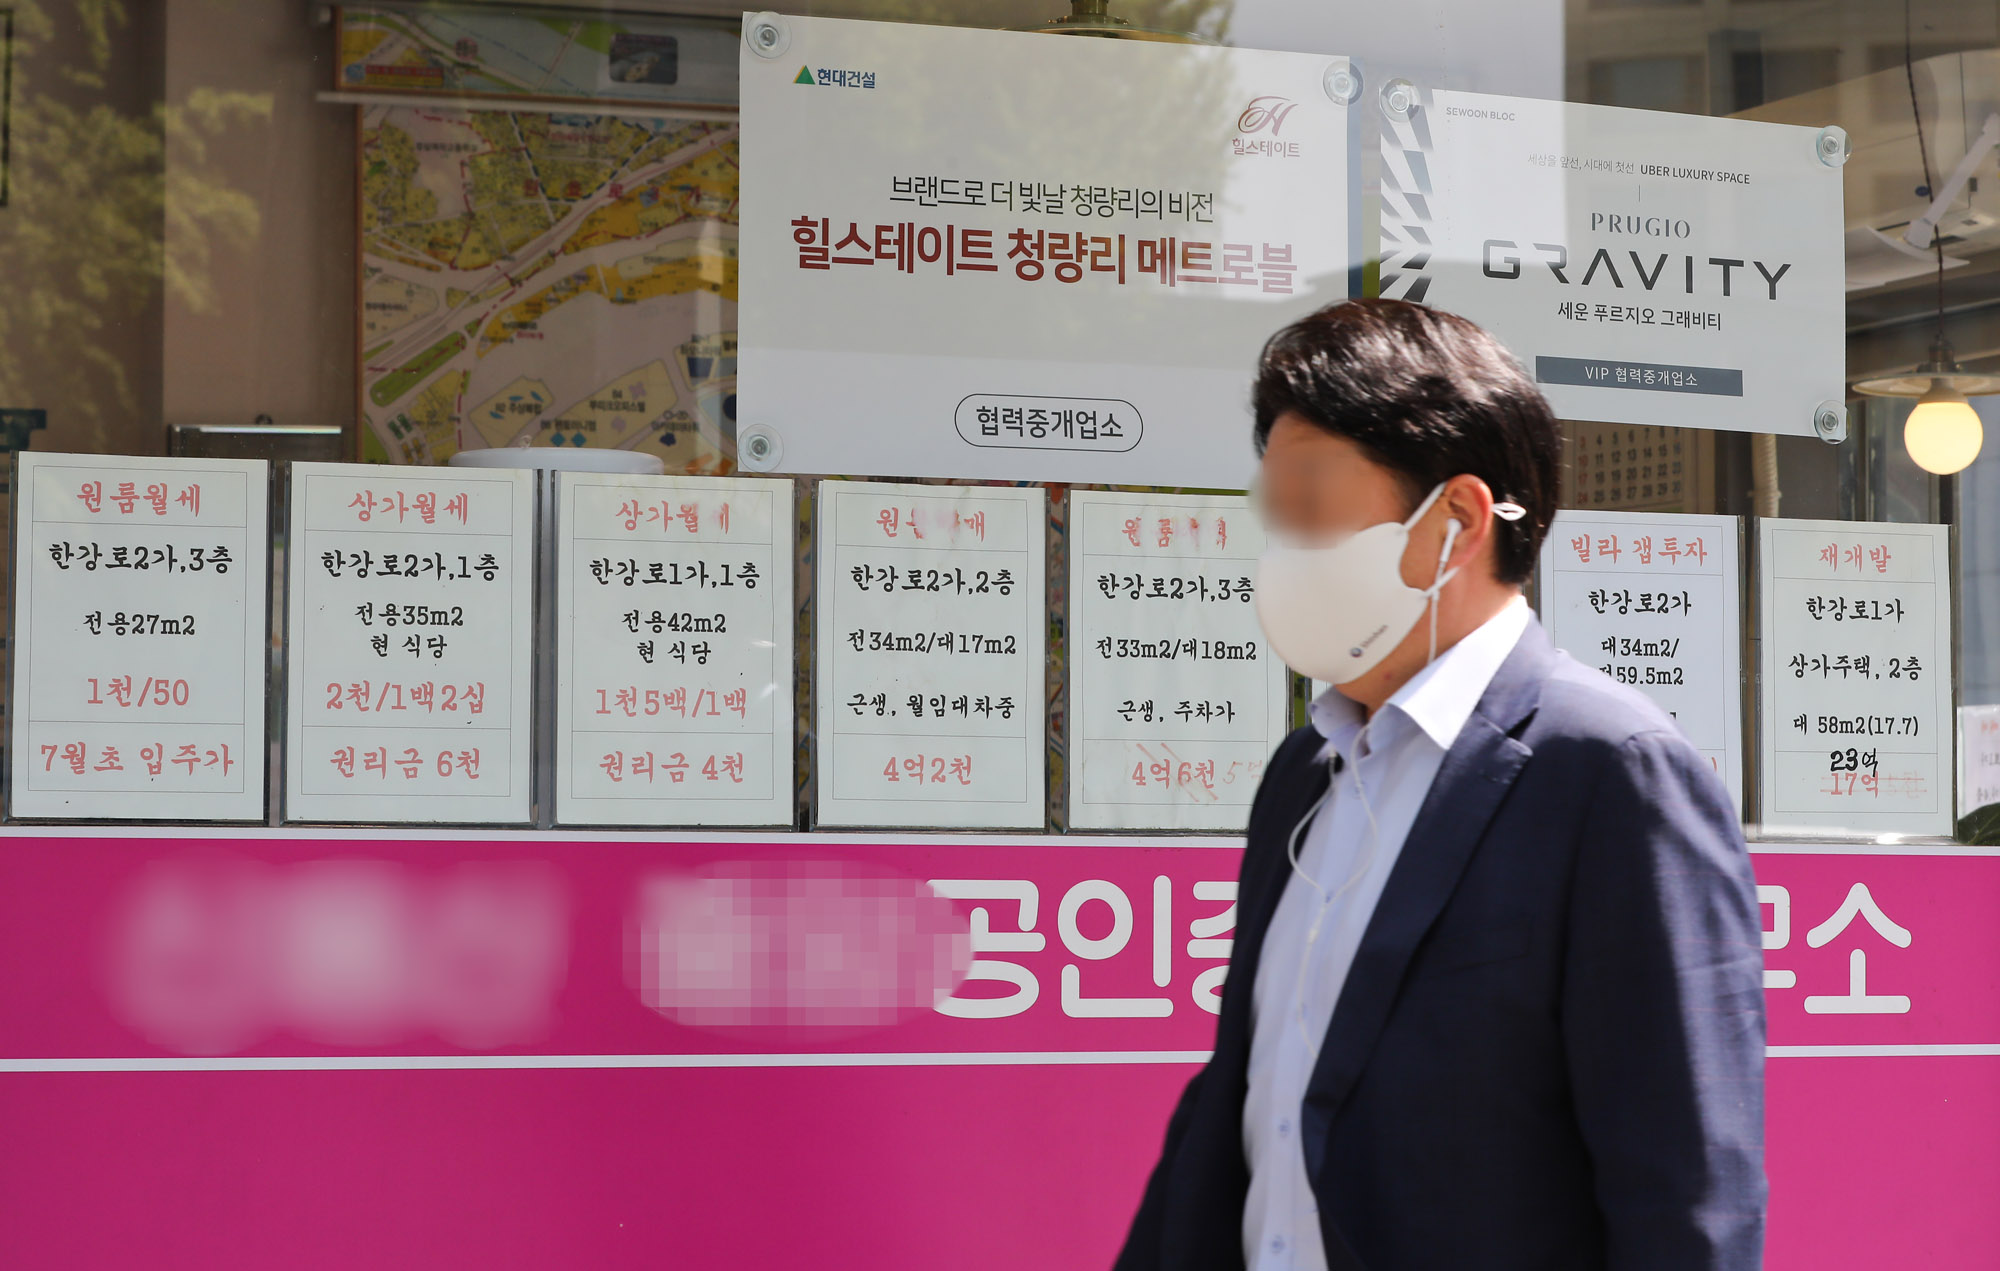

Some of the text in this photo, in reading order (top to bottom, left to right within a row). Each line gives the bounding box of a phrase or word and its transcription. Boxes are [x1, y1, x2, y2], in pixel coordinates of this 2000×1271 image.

[818, 69, 875, 88] 현대건설
[1445, 106, 1516, 122] SEWOON BLOC
[1231, 136, 1302, 159] 힐스테이트
[1560, 155, 1582, 171] 앞선,
[1584, 158, 1613, 173] 시대에
[1615, 159, 1635, 175] 첫선
[1641, 165, 1669, 176] UBER
[1673, 168, 1714, 180] LUXURY
[1717, 172, 1750, 184] SPACE
[890, 176, 1213, 222] 브랜드로 더 빛날 청량리의 비전
[1592, 213, 1690, 238] PRUGIO
[791, 216, 1298, 294] 힐스테이트 청량리 메트로블
[1482, 240, 1792, 300] GRAVITY
[1558, 302, 1720, 331] 세운 푸르지오 그래비티
[1585, 367, 1698, 387] VIP 협력중개업소
[976, 406, 1123, 439] 협력중개업소
[77, 481, 200, 517] 원룸월세
[348, 490, 467, 525] 상가월세
[876, 507, 984, 541] 원매
[49, 542, 232, 573] 한강로2가,3층
[1571, 534, 1707, 566] 빌라 갭투자
[1819, 543, 1891, 573] 재개발
[321, 550, 499, 581] 한강로2가,1층
[590, 558, 760, 589] 한강로1가,1층
[851, 564, 1014, 595] 한강로2가,2층
[1097, 573, 1254, 602] 한강로2가,3층
[1588, 589, 1691, 616] 한강로2가
[83, 611, 195, 636] 전용27m2
[355, 602, 463, 626] 전용35m2
[622, 610, 726, 633] 전용42m2
[1806, 596, 1904, 623] 한강로1가
[371, 634, 447, 658] 현 식당
[637, 640, 711, 664] 현 식당
[1789, 653, 1922, 680] 상가주택, 2층
[88, 676, 189, 707] 1천/50
[326, 680, 484, 714] 2천/1백2십
[596, 686, 746, 719] 1천5백/1백
[907, 694, 1015, 719] 월임대차중
[1117, 700, 1235, 723] 근생, 주차가
[1794, 714, 1918, 736] 대 58m2(17.7)
[41, 742, 234, 776] 7월초 입주가
[330, 746, 480, 779] 권리금 6천
[600, 751, 743, 783] 권리금 4천
[883, 754, 971, 785] 4억2천
[1131, 758, 1214, 789] 4억6천
[1830, 747, 1878, 777] 23억
[1830, 770, 1879, 799] 17억
